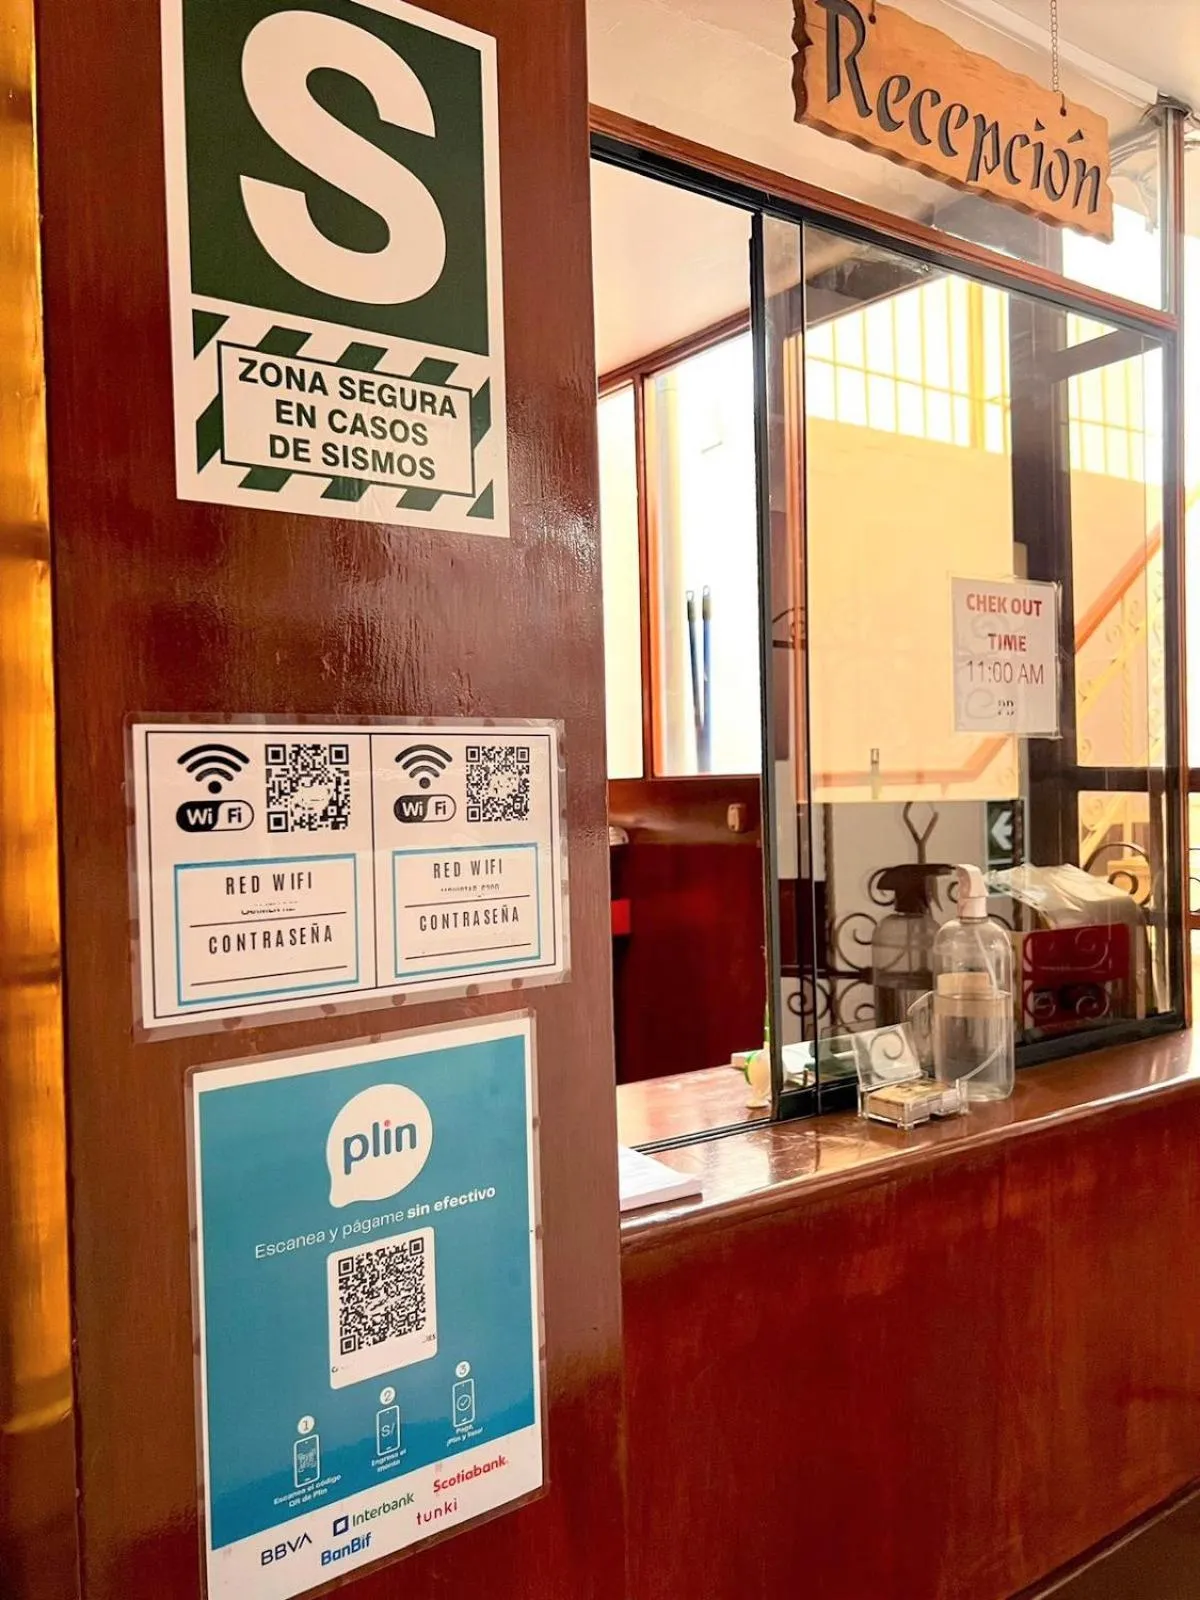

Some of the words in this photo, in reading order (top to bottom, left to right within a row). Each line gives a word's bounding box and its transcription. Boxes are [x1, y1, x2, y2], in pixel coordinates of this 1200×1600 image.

[814, 0, 1100, 214] Recepción
[240, 10, 446, 304] S
[238, 357, 328, 396] ZONA
[338, 376, 457, 419] SEGURA
[275, 399, 316, 429] EN
[327, 408, 429, 447] CASOS
[269, 434, 311, 463] DE
[321, 442, 436, 481] SISMOS
[966, 593, 1008, 614] CHEK
[1011, 598, 1042, 616] OUT
[988, 633, 1027, 652] TIME
[967, 660, 1013, 684] 11:00
[1018, 663, 1045, 685] AM
[226, 875, 260, 895] RED
[273, 871, 312, 891] WIFI
[433, 861, 461, 879] RED
[470, 858, 503, 876] WIFI
[420, 904, 519, 931] CONTRASEÑA
[209, 923, 332, 954] CONTRASEÑA
[343, 1119, 417, 1175] plin
[254, 1231, 325, 1259] Escanea
[329, 1226, 339, 1243] y
[342, 1210, 404, 1240] págame
[407, 1202, 431, 1219] sin
[434, 1186, 496, 1212] efectivo
[381, 1422, 395, 1437] S/
[433, 1455, 507, 1493] Scotiabank
[352, 1492, 415, 1527] Interbank
[416, 1498, 458, 1525] tunki
[261, 1532, 312, 1566] BBVA
[321, 1532, 373, 1566] BanBif
